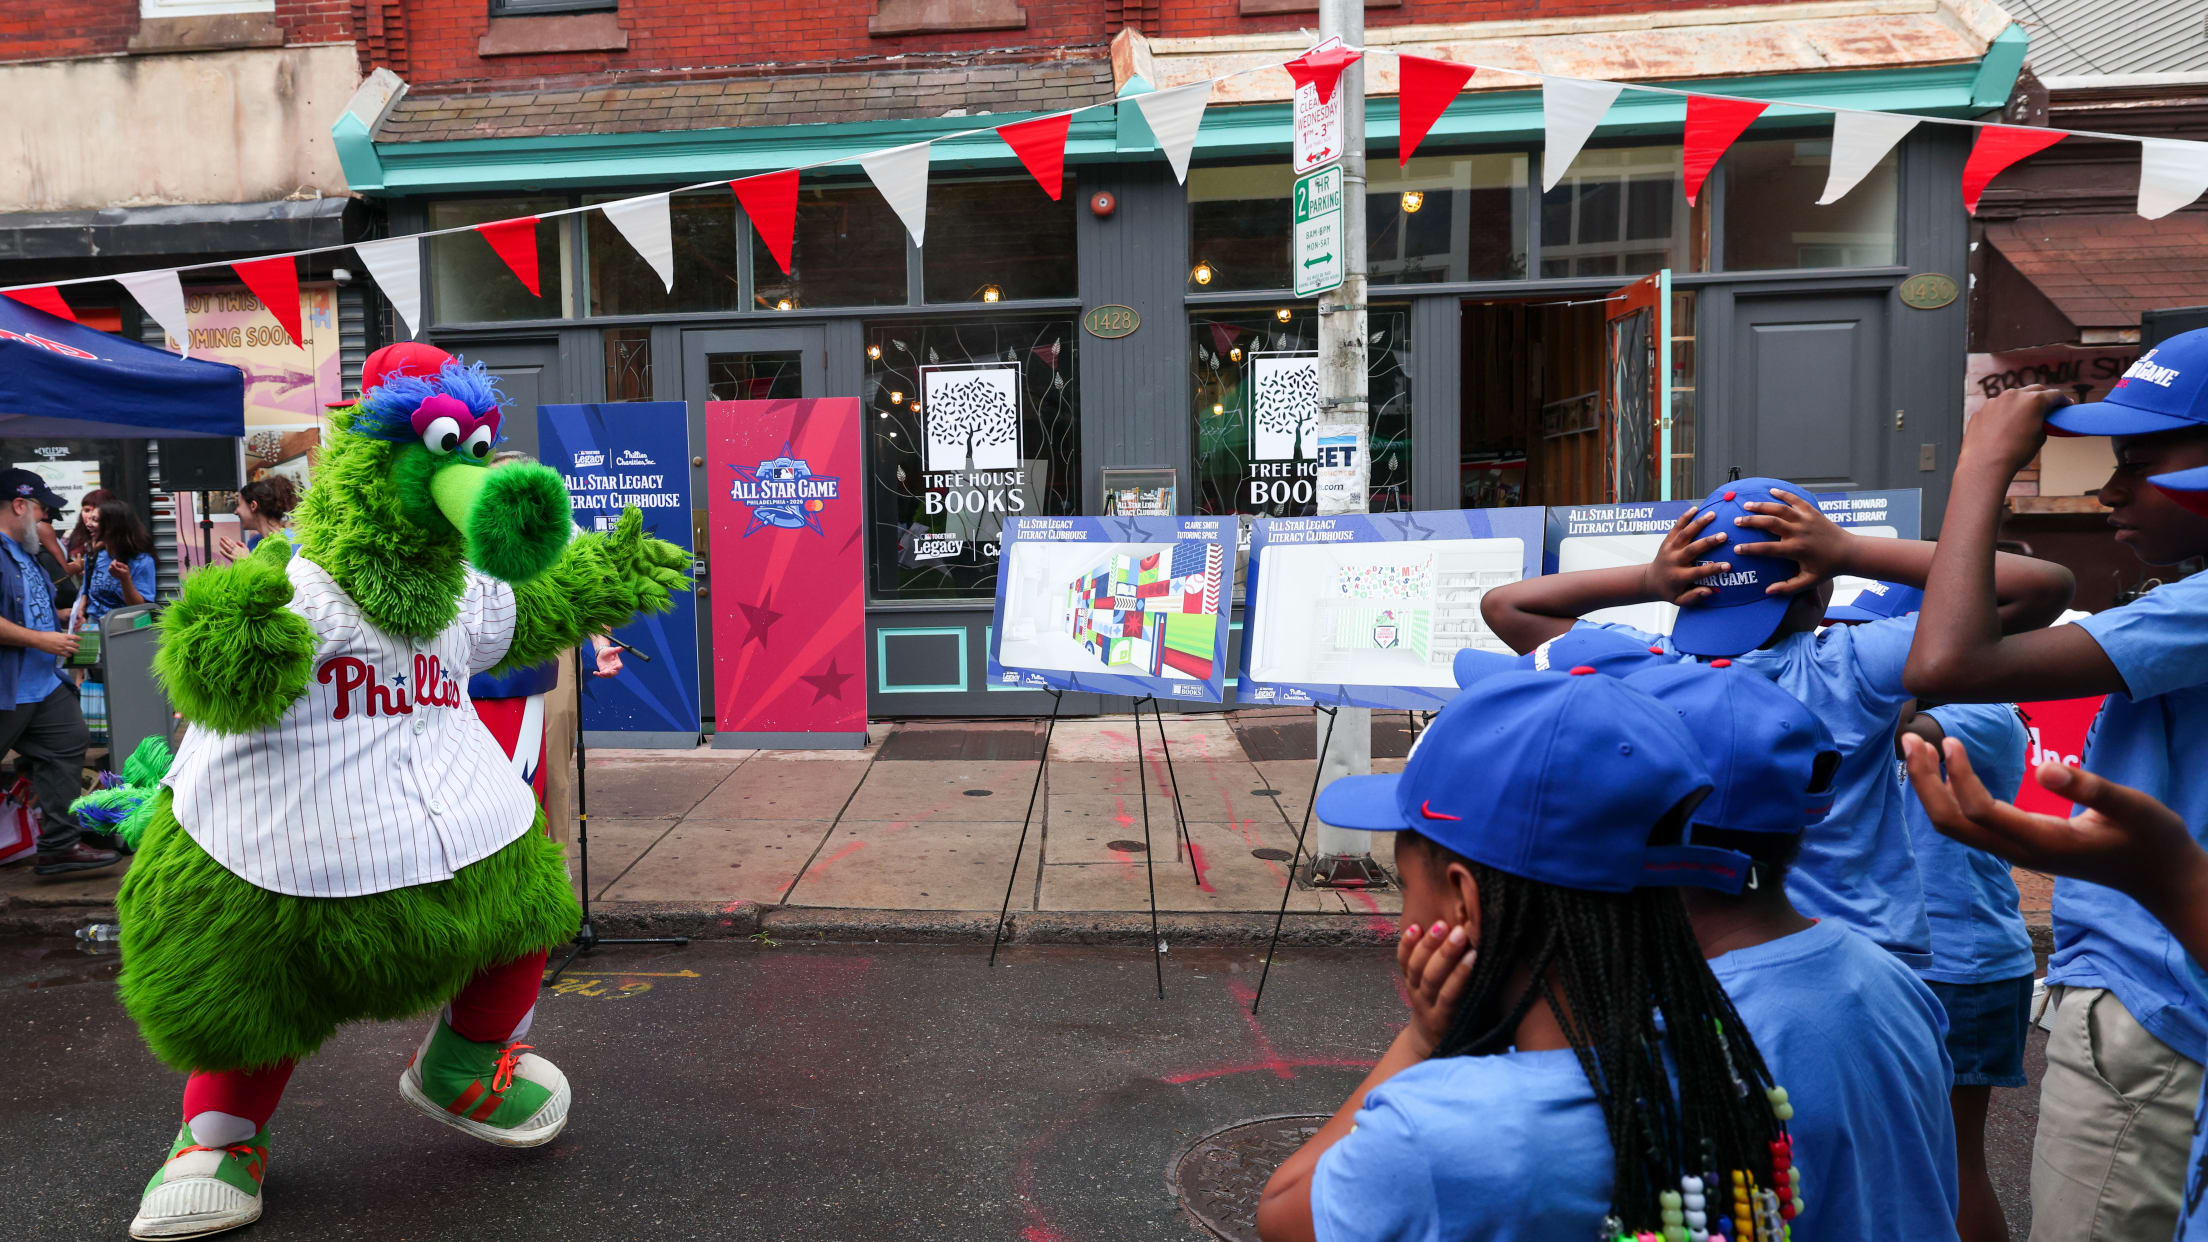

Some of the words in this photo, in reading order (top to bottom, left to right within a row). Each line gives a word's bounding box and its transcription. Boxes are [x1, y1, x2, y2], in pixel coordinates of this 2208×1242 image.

[1298, 101, 1338, 131] WEDNESDAY
[1298, 187, 1306, 216] 2
[1317, 176, 1330, 194] HR
[1309, 191, 1339, 215] PARKING
[1092, 311, 1131, 331] 1428
[574, 453, 605, 465] Legacy
[1249, 463, 1291, 478] TREE
[619, 474, 664, 490] LEGACY
[923, 474, 964, 488] TREE
[969, 472, 1025, 486] HOUSE
[798, 479, 838, 498] GAME
[1251, 480, 1313, 504] BOO
[568, 494, 608, 509] ERACY
[610, 492, 680, 509] CLUBHOUSE
[925, 488, 1025, 515] BOOKS
[1851, 498, 1888, 509] HOWARD
[1615, 507, 1654, 519] LEGACY
[1853, 511, 1888, 521] LIBRARY
[1048, 518, 1073, 529] LEGACY
[1202, 521, 1219, 530] SMITH
[1305, 519, 1336, 530] LEGACY
[1569, 522, 1615, 534] LITERACY
[1616, 520, 1678, 532] CLUBHOUSE
[1017, 529, 1047, 539] LITERACY
[1048, 529, 1088, 540] CLUBHOUSE
[1177, 531, 1202, 540] TUTORING
[1201, 531, 1218, 540] SPACE
[1268, 532, 1304, 543] LITERACY
[1305, 530, 1355, 541] CLUBHOUSE
[914, 539, 963, 558] Legacy
[1720, 570, 1759, 586] GAME
[317, 653, 460, 720] Phillies
